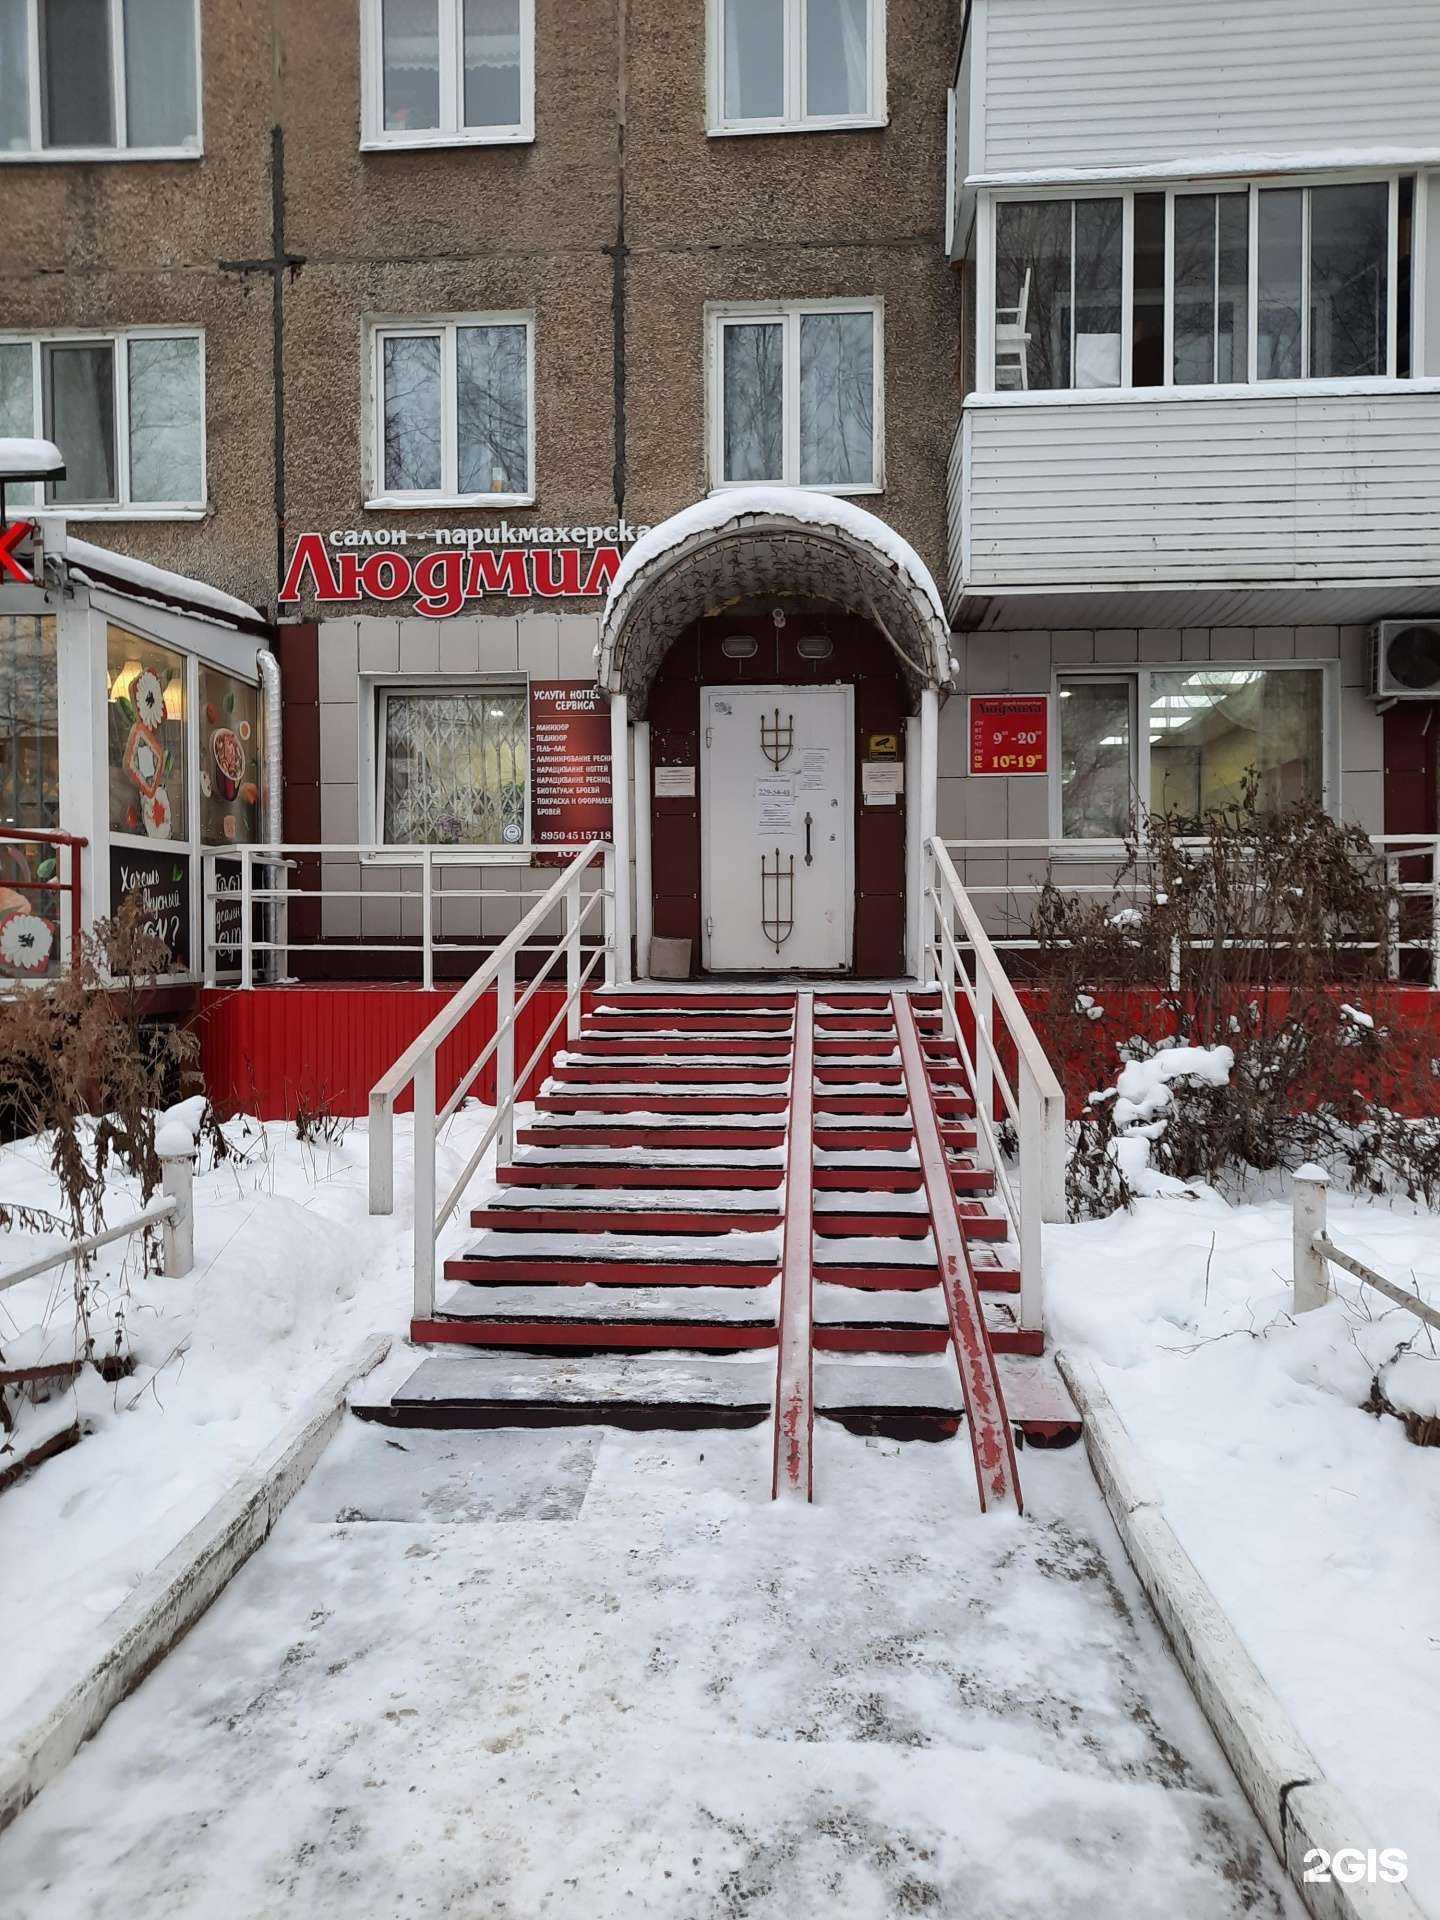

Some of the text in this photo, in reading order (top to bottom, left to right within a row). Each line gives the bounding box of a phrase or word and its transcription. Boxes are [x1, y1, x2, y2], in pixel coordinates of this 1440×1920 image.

[329, 529, 407, 546] салон
[435, 519, 651, 550] парикмахерска
[279, 533, 622, 618] Людмил
[534, 689, 600, 700] УСЛУГИ НОГТЕ
[555, 701, 595, 711] СЕРВИСА
[577, 796, 613, 805] ОФОРМЛЕН
